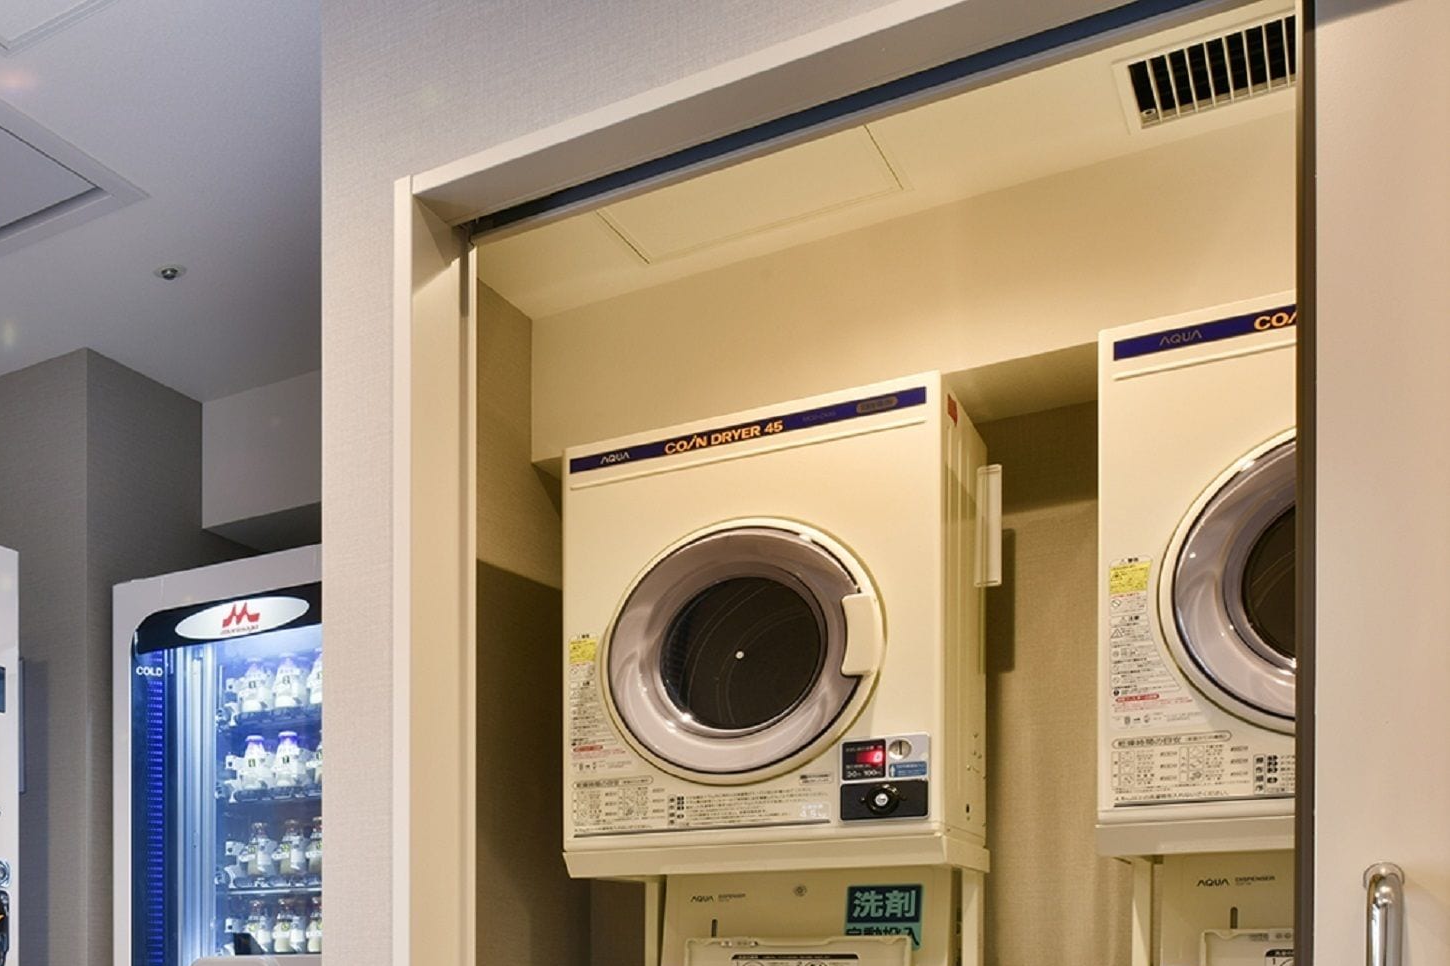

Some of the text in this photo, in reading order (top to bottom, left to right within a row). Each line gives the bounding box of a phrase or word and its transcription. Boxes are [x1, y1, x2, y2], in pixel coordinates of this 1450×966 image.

[1158, 329, 1203, 346] AQUA
[600, 452, 631, 465] AQUA
[710, 426, 762, 447] DRYER
[763, 420, 784, 434] 45
[135, 666, 163, 677] COLD
[1197, 878, 1231, 888] AQUA
[690, 894, 715, 903] AQUA
[851, 889, 919, 919] 洗剤
